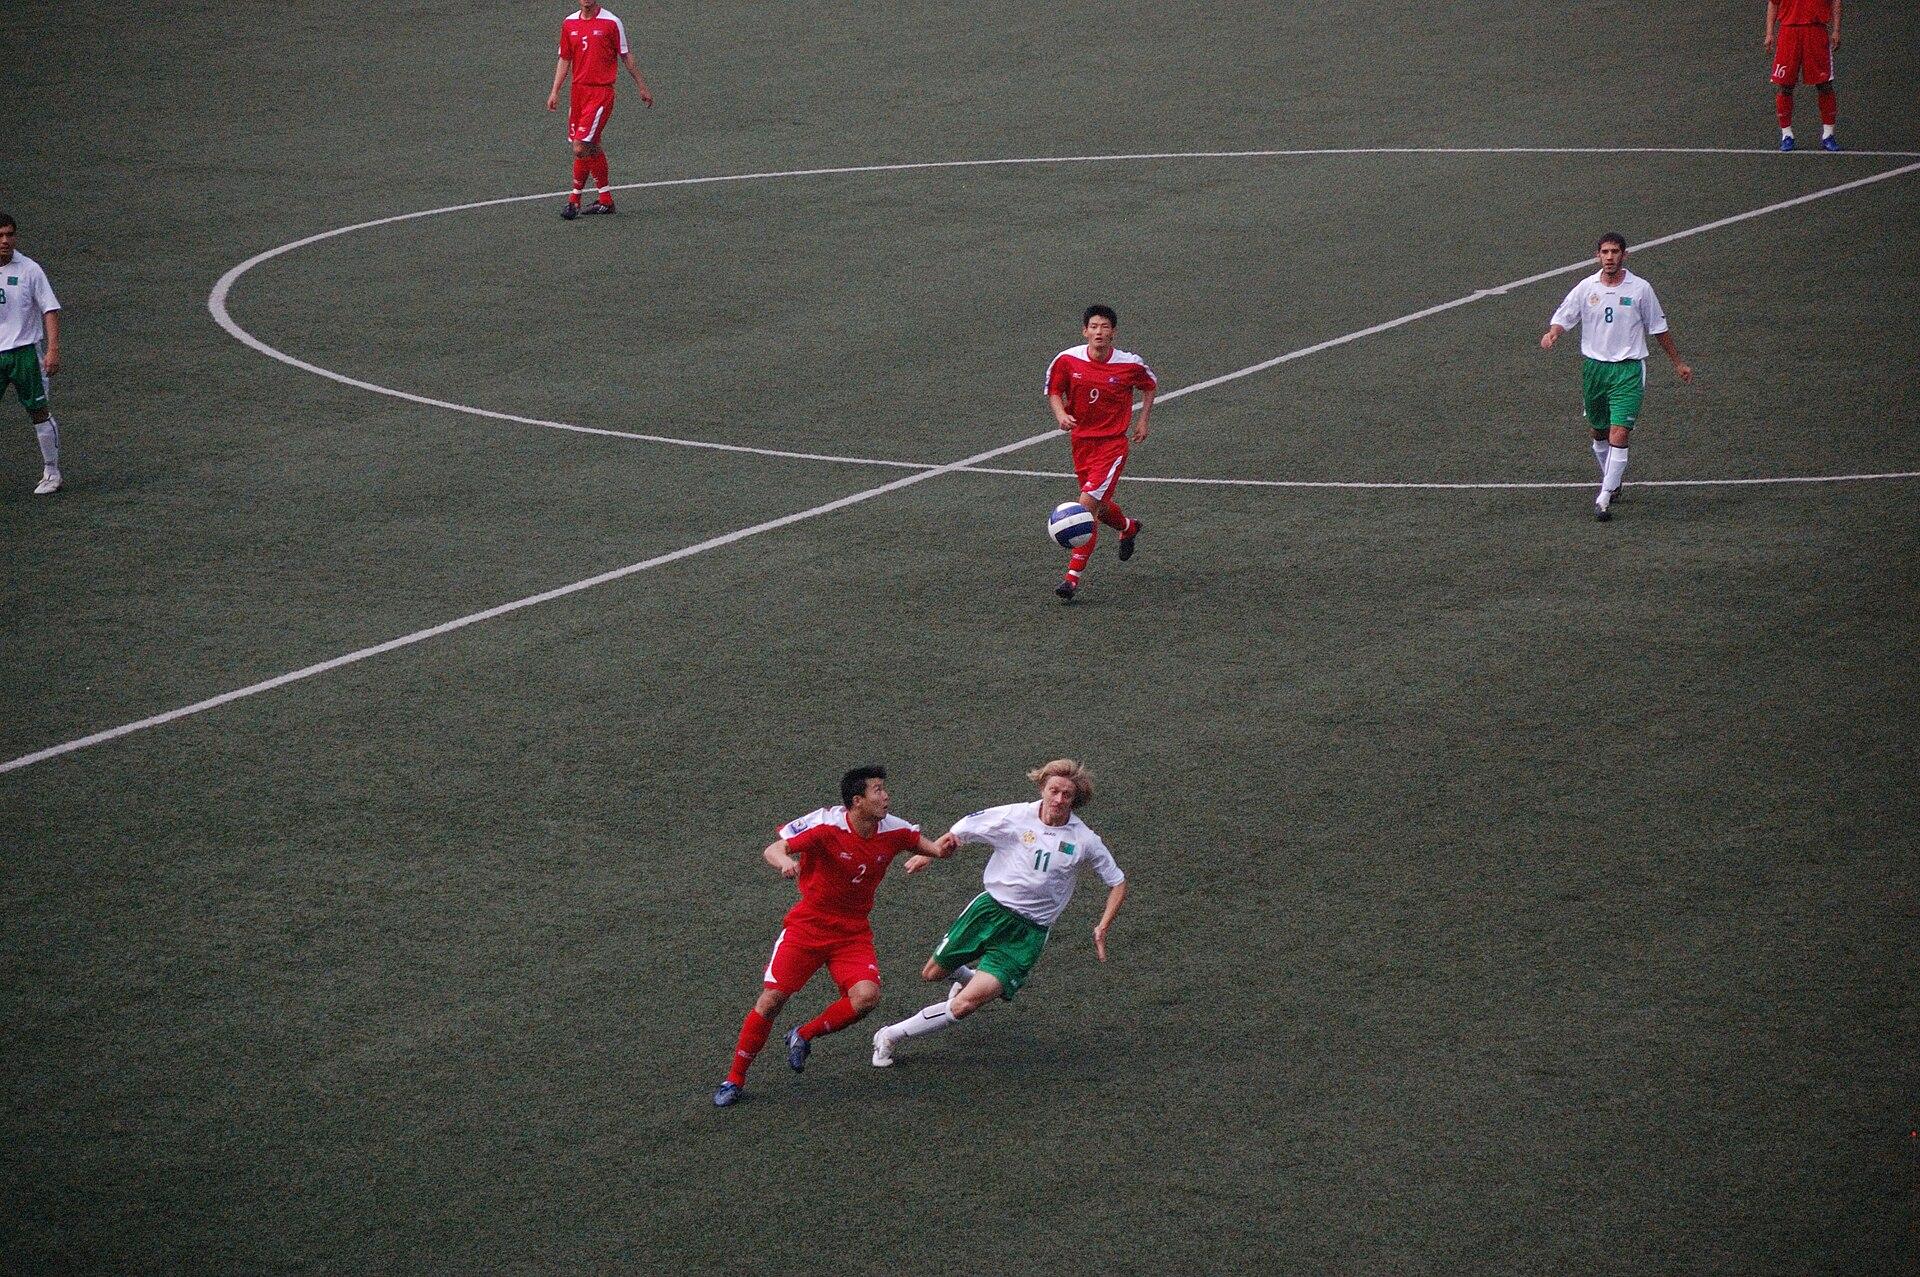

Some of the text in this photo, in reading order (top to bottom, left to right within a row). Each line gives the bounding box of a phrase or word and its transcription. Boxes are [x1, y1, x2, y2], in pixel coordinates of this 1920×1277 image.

[582, 35, 588, 51] 5
[1773, 63, 1787, 79] 16
[1605, 306, 1614, 324] 8
[1088, 388, 1100, 404] 9
[1034, 849, 1051, 873] 11
[851, 863, 867, 883] 2
